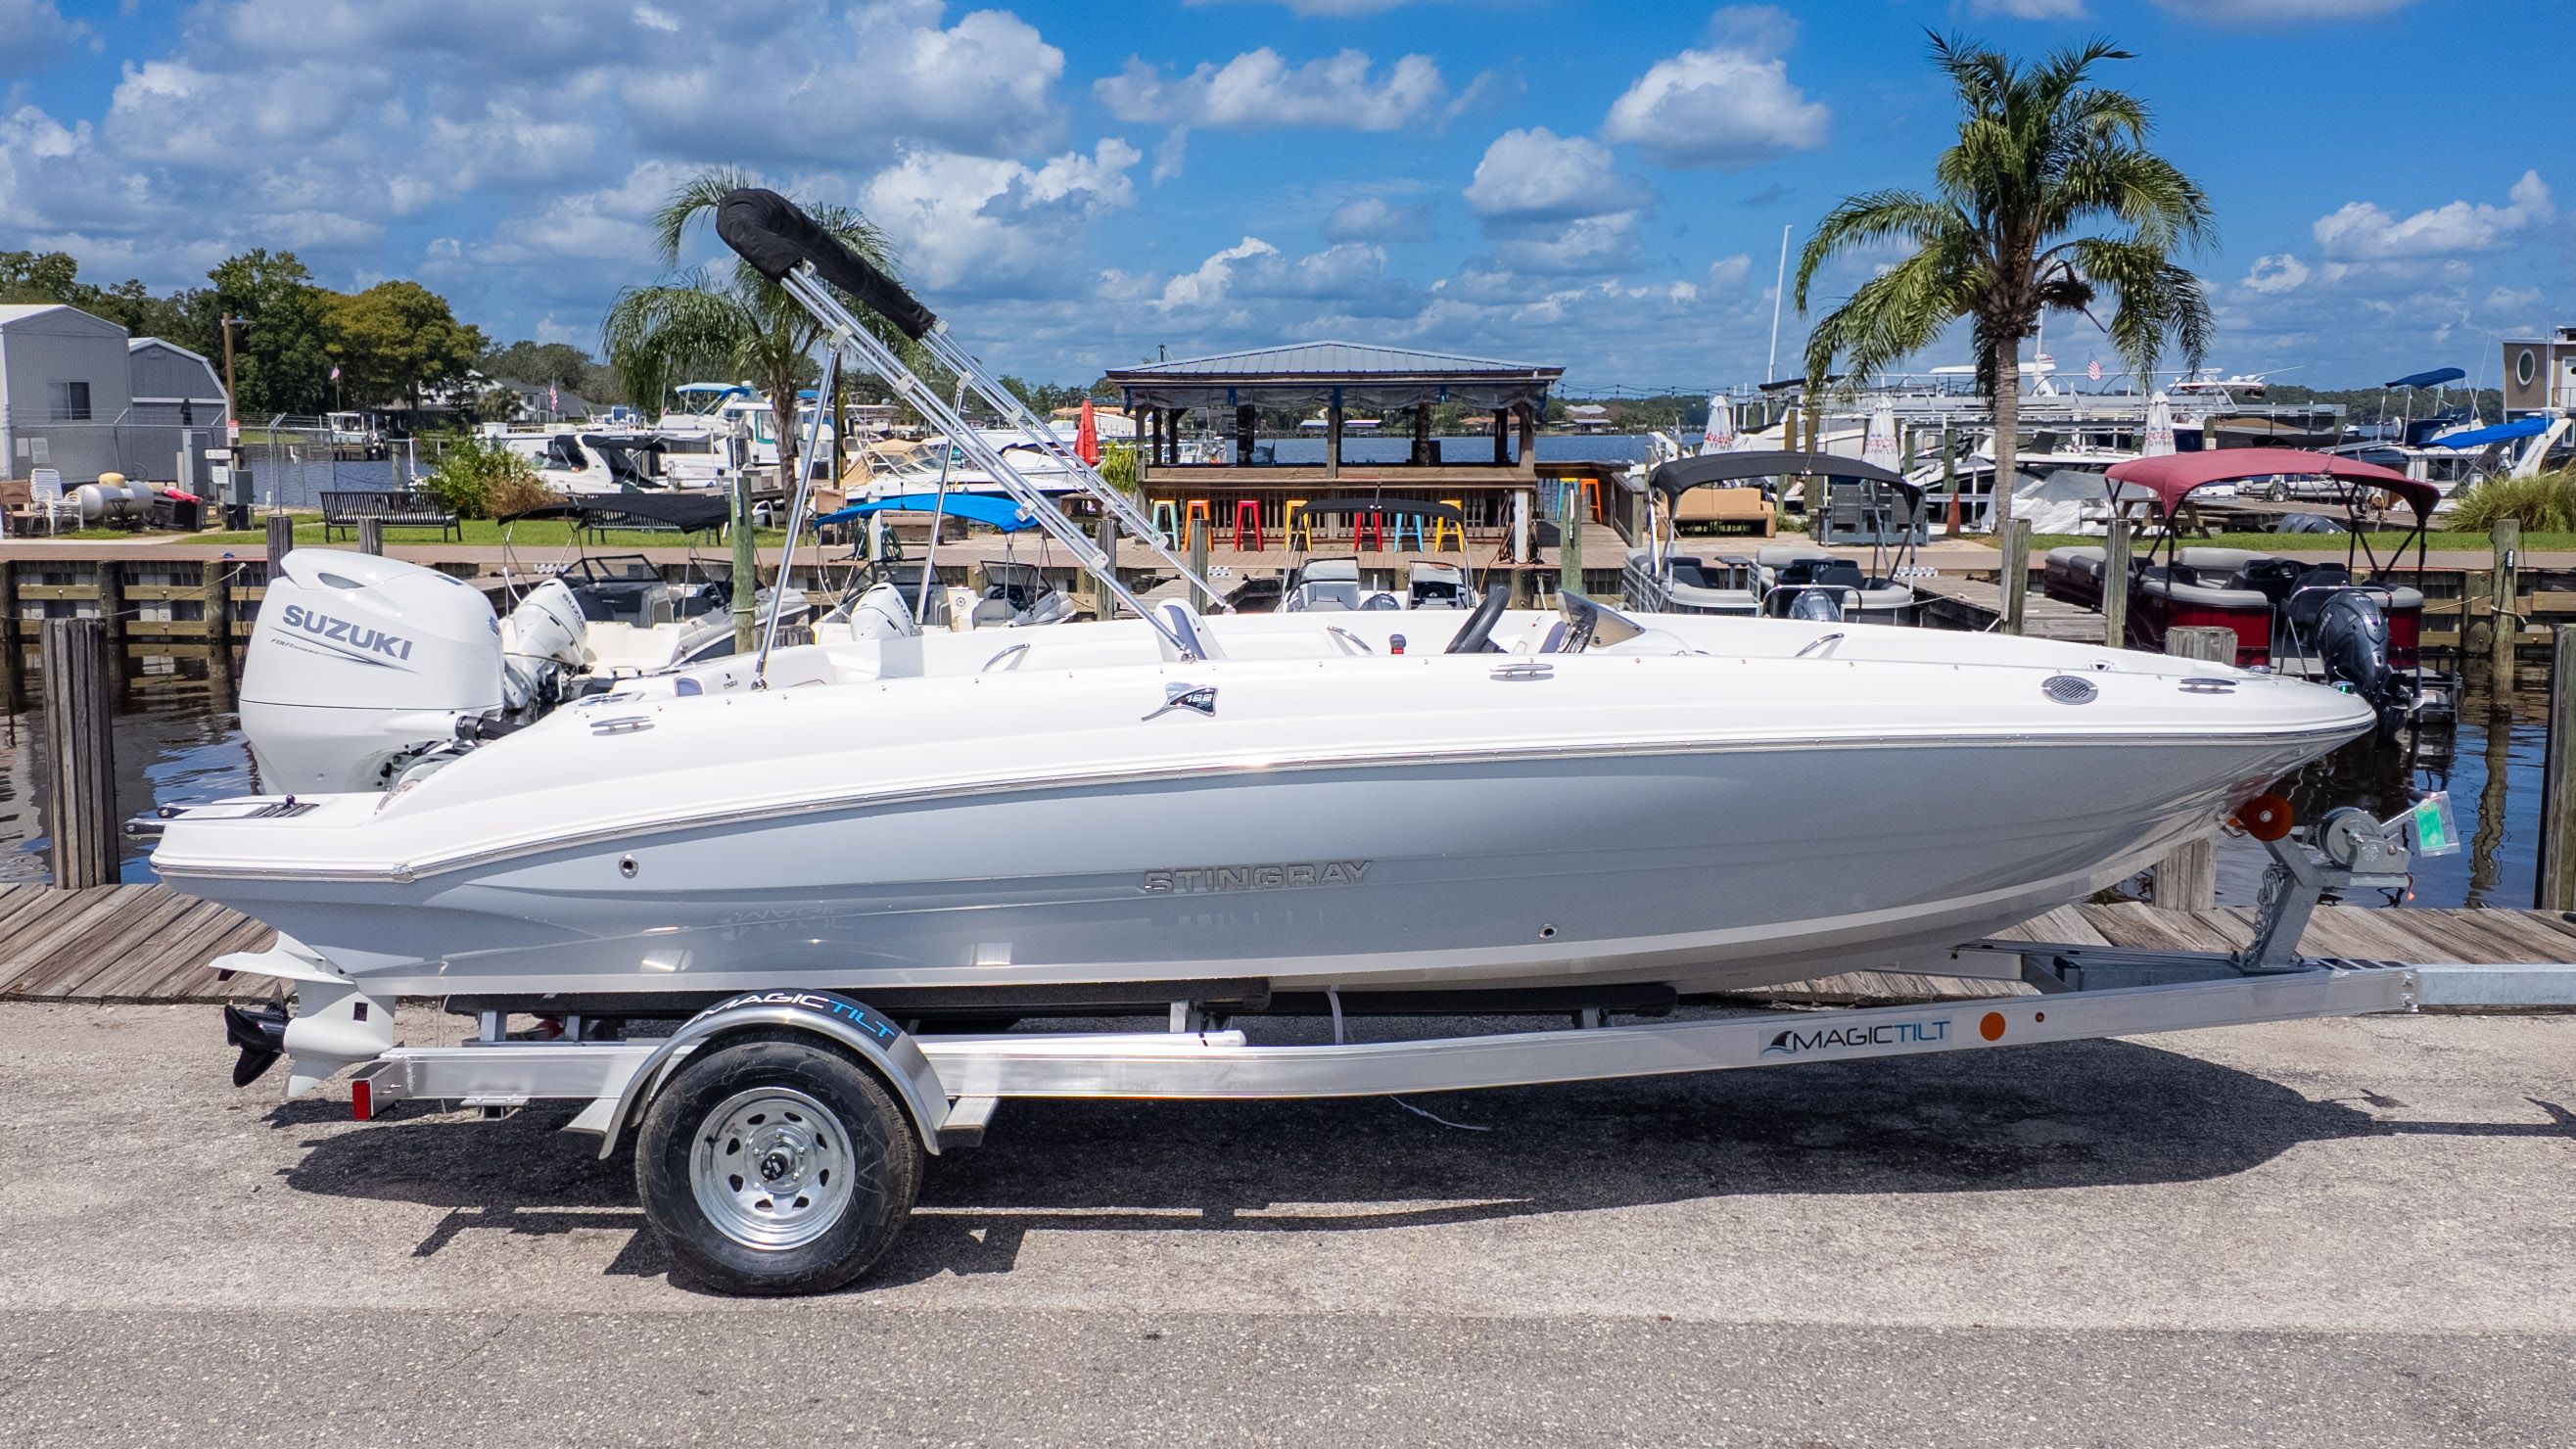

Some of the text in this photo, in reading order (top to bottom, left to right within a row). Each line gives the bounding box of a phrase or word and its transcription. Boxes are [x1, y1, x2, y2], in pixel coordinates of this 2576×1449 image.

[283, 604, 413, 661] SUZUKI
[1144, 861, 1374, 893] STINGRAY
[694, 992, 896, 1038] MAGICTILT
[1793, 1020, 1951, 1052] MAGICTILT
